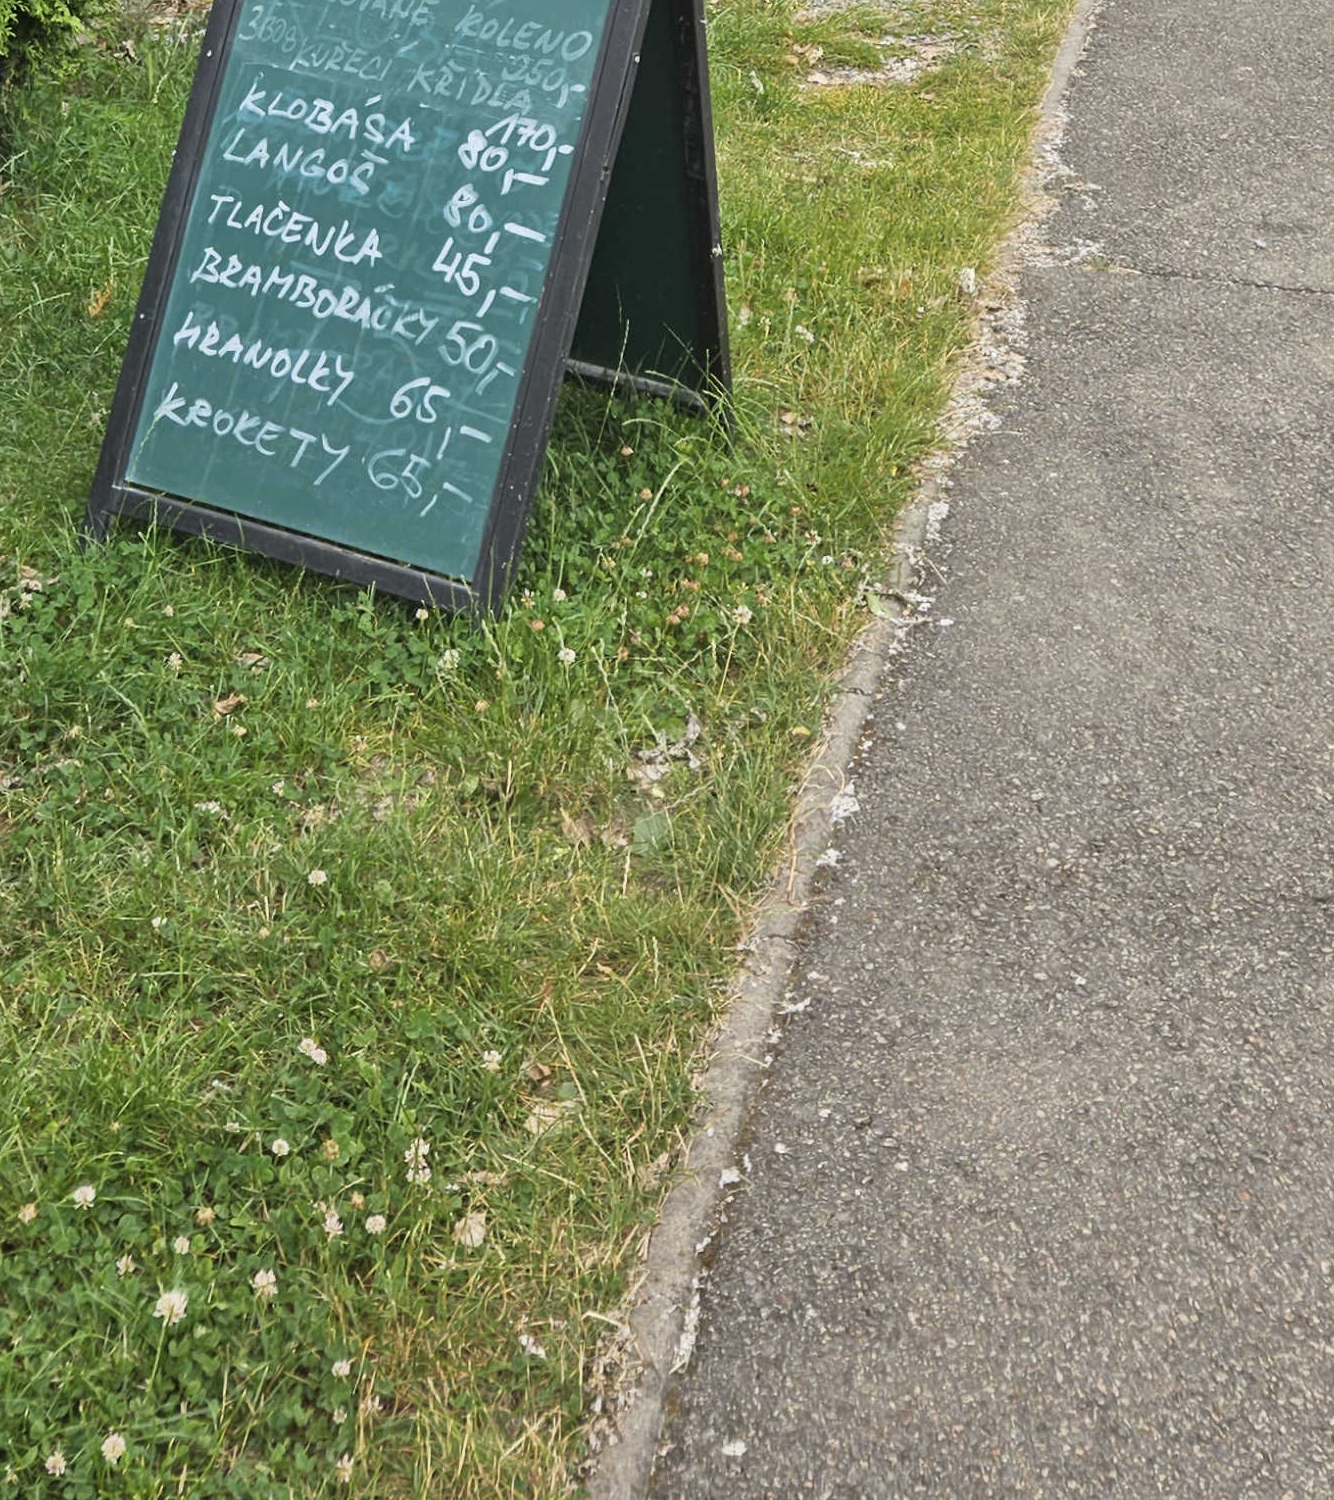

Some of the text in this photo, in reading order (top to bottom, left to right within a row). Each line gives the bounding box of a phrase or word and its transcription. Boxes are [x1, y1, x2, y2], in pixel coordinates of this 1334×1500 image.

[454, 4, 593, 62] KOLENO
[239, 82, 416, 152] KLOBÁSA
[223, 128, 389, 195] LANGOŠ
[207, 194, 384, 267] TLAČENKA
[173, 311, 355, 406] HRANOLKY
[154, 382, 351, 485] KROKETY
